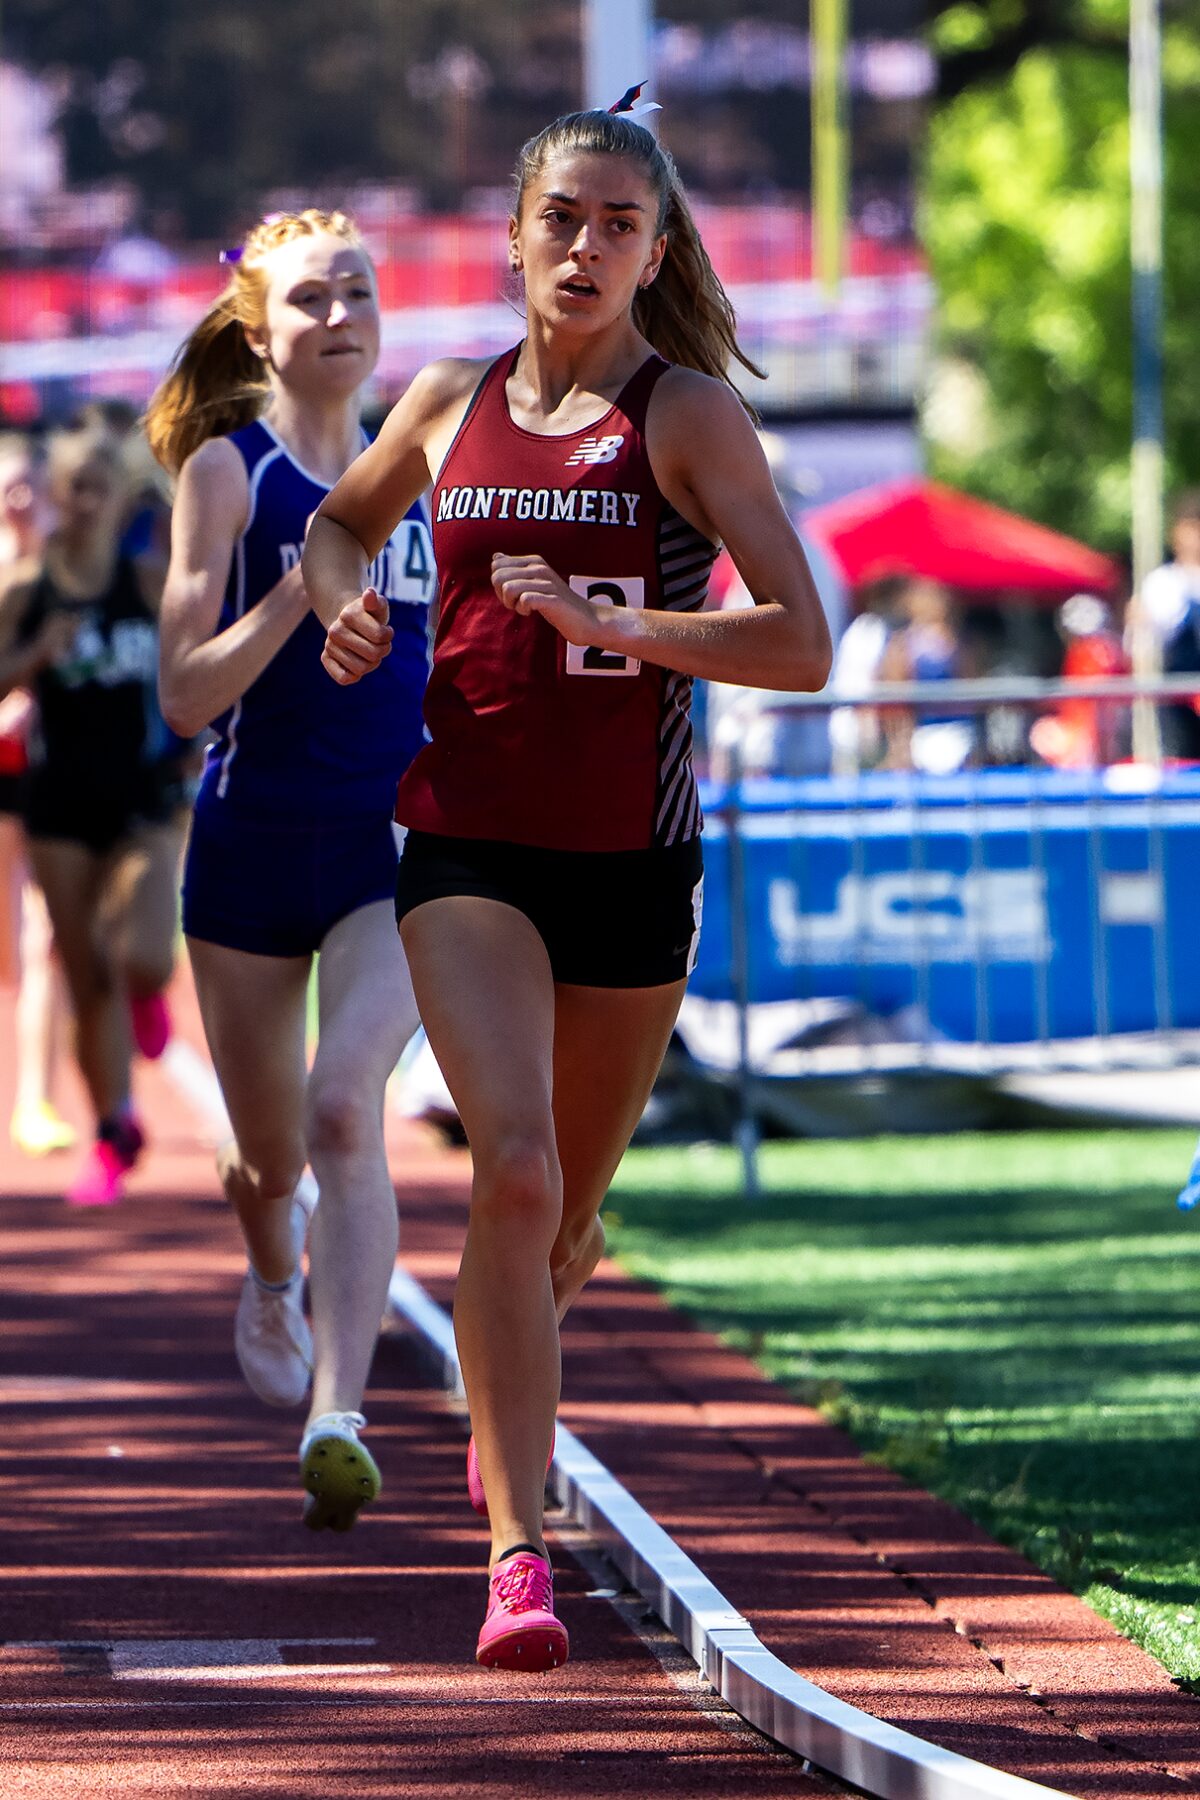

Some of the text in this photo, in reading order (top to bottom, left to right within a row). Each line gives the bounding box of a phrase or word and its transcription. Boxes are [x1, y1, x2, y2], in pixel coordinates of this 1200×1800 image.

[436, 487, 641, 526] MONTGOMERY
[404, 525, 431, 597] 4
[582, 582, 627, 670] 2
